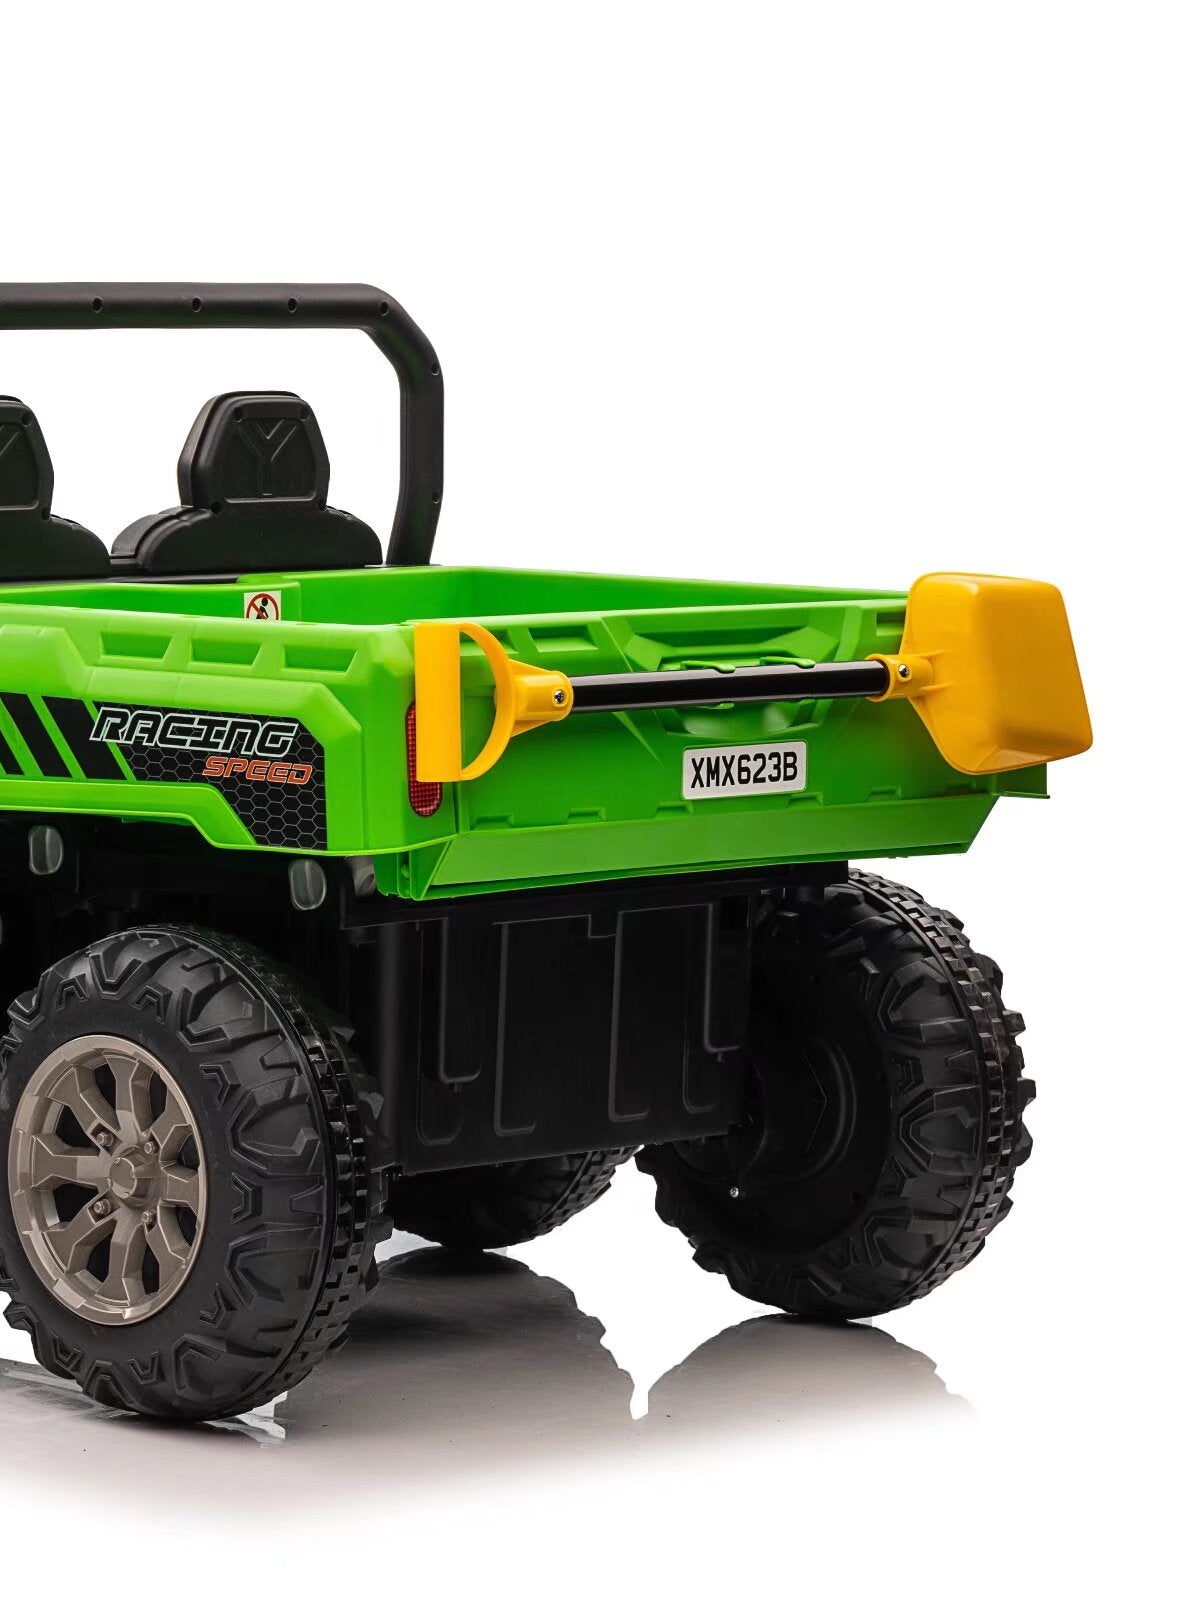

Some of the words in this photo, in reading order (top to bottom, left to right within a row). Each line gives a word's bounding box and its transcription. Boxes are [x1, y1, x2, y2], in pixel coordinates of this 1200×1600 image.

[89, 706, 299, 758] RACING
[202, 755, 313, 785] SPEED
[690, 751, 798, 789] XMX623B
